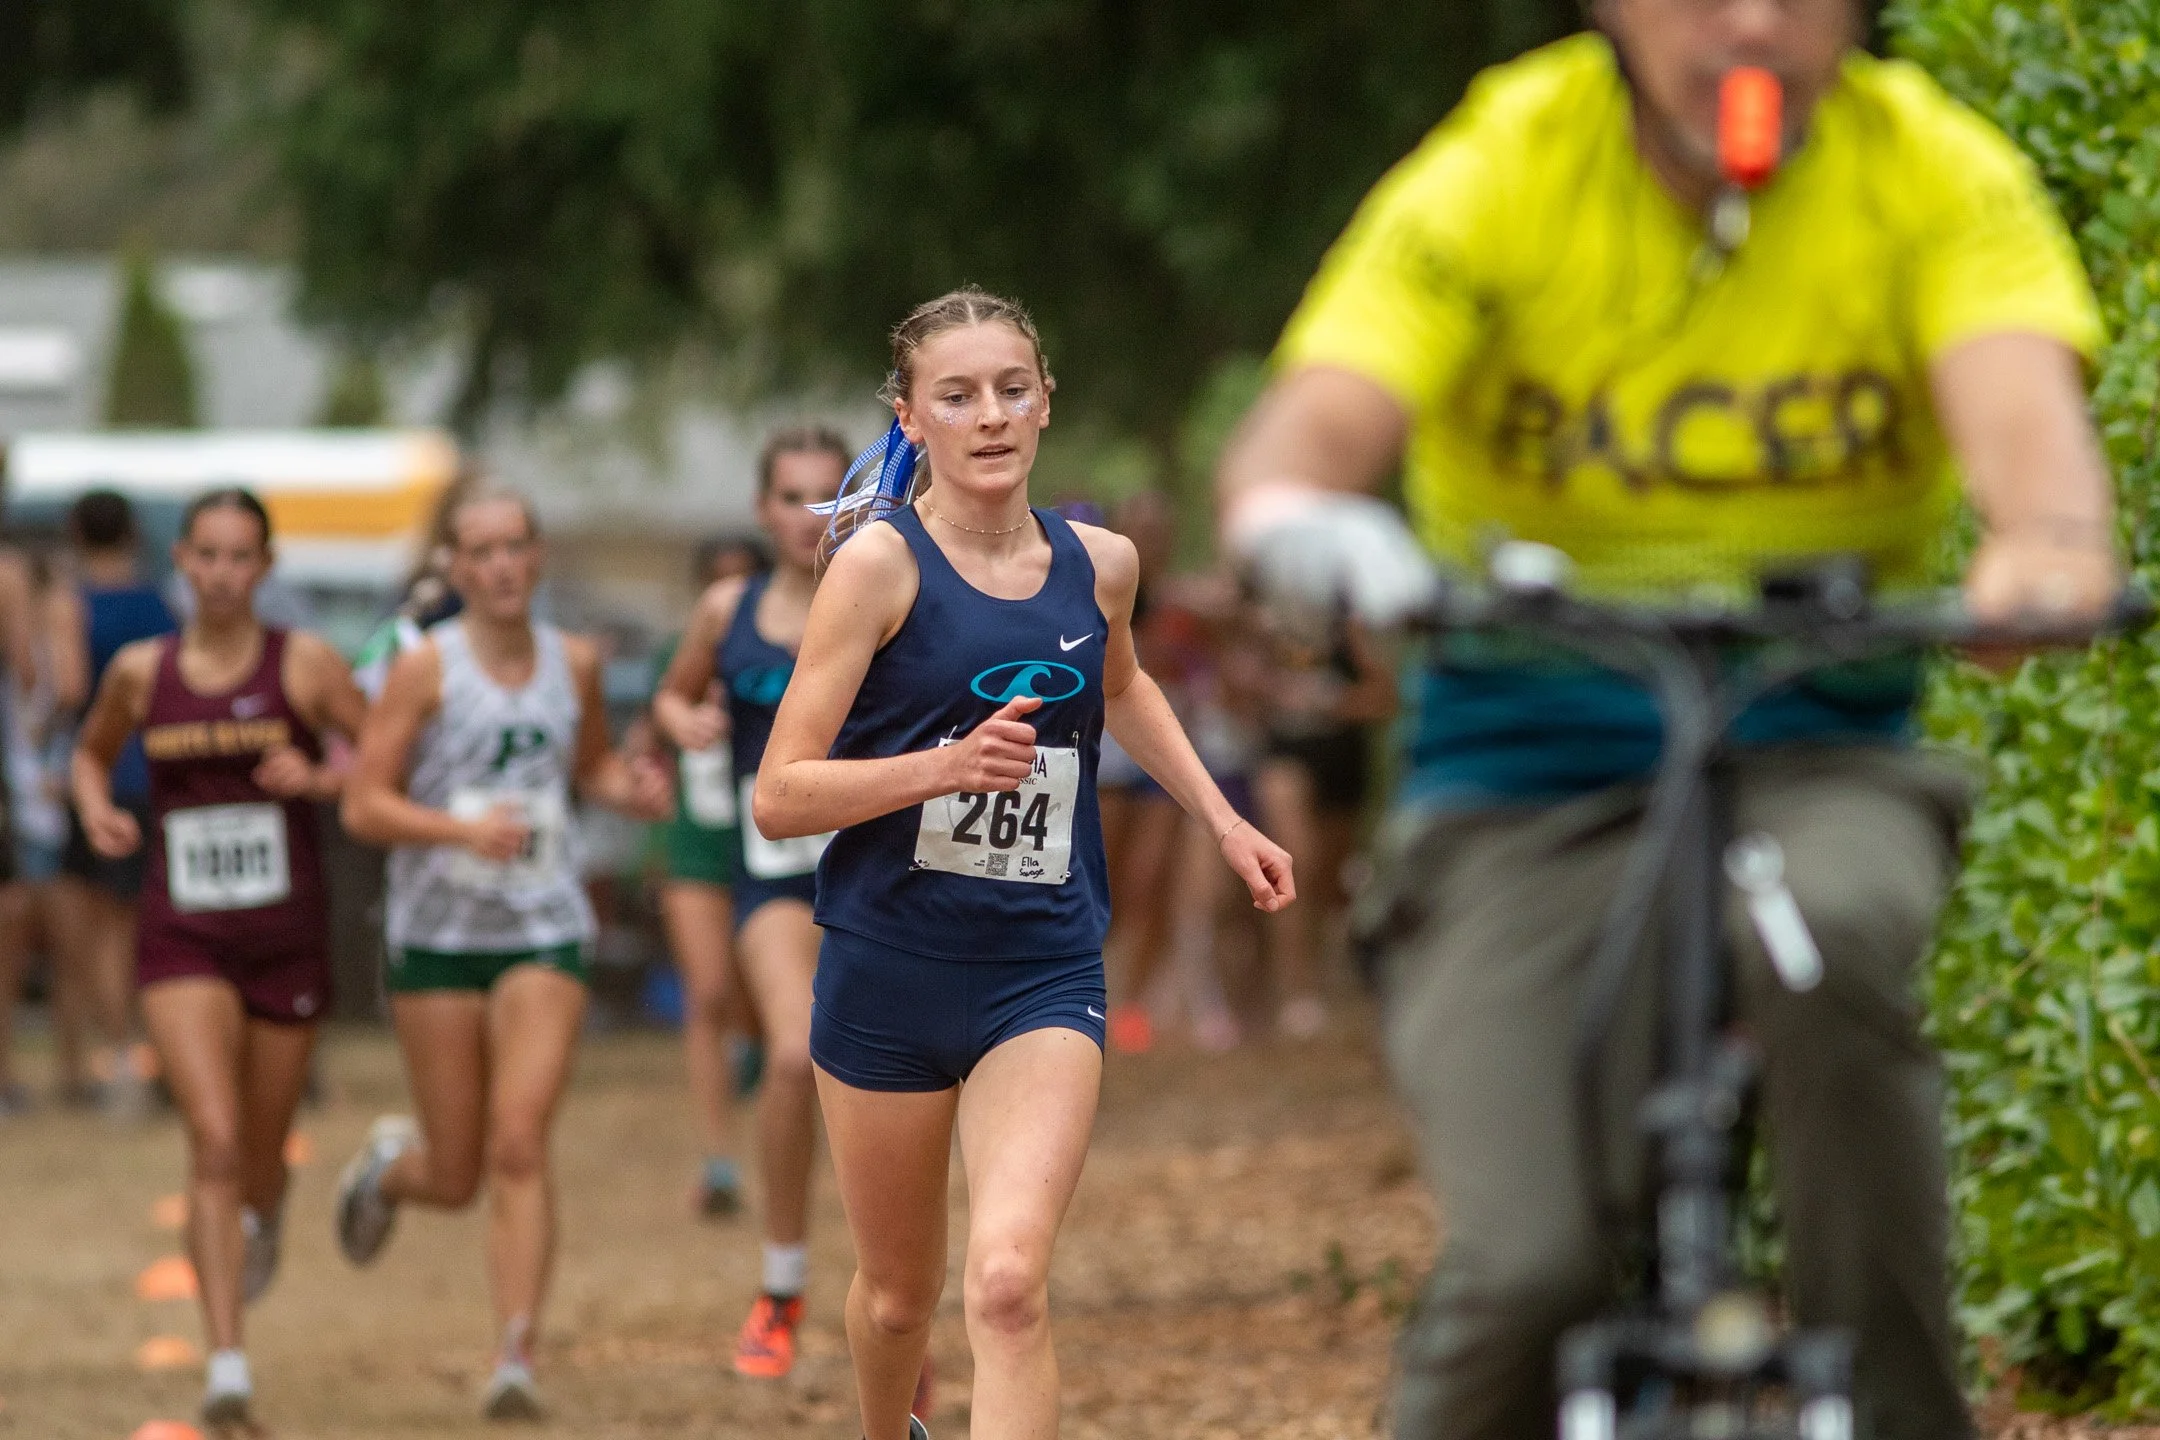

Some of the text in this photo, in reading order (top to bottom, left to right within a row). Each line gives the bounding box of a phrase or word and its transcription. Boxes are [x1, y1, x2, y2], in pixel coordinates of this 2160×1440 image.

[1491, 368, 1904, 494] PACER
[951, 790, 1051, 852] 264
[1021, 856, 1040, 868] Ella
